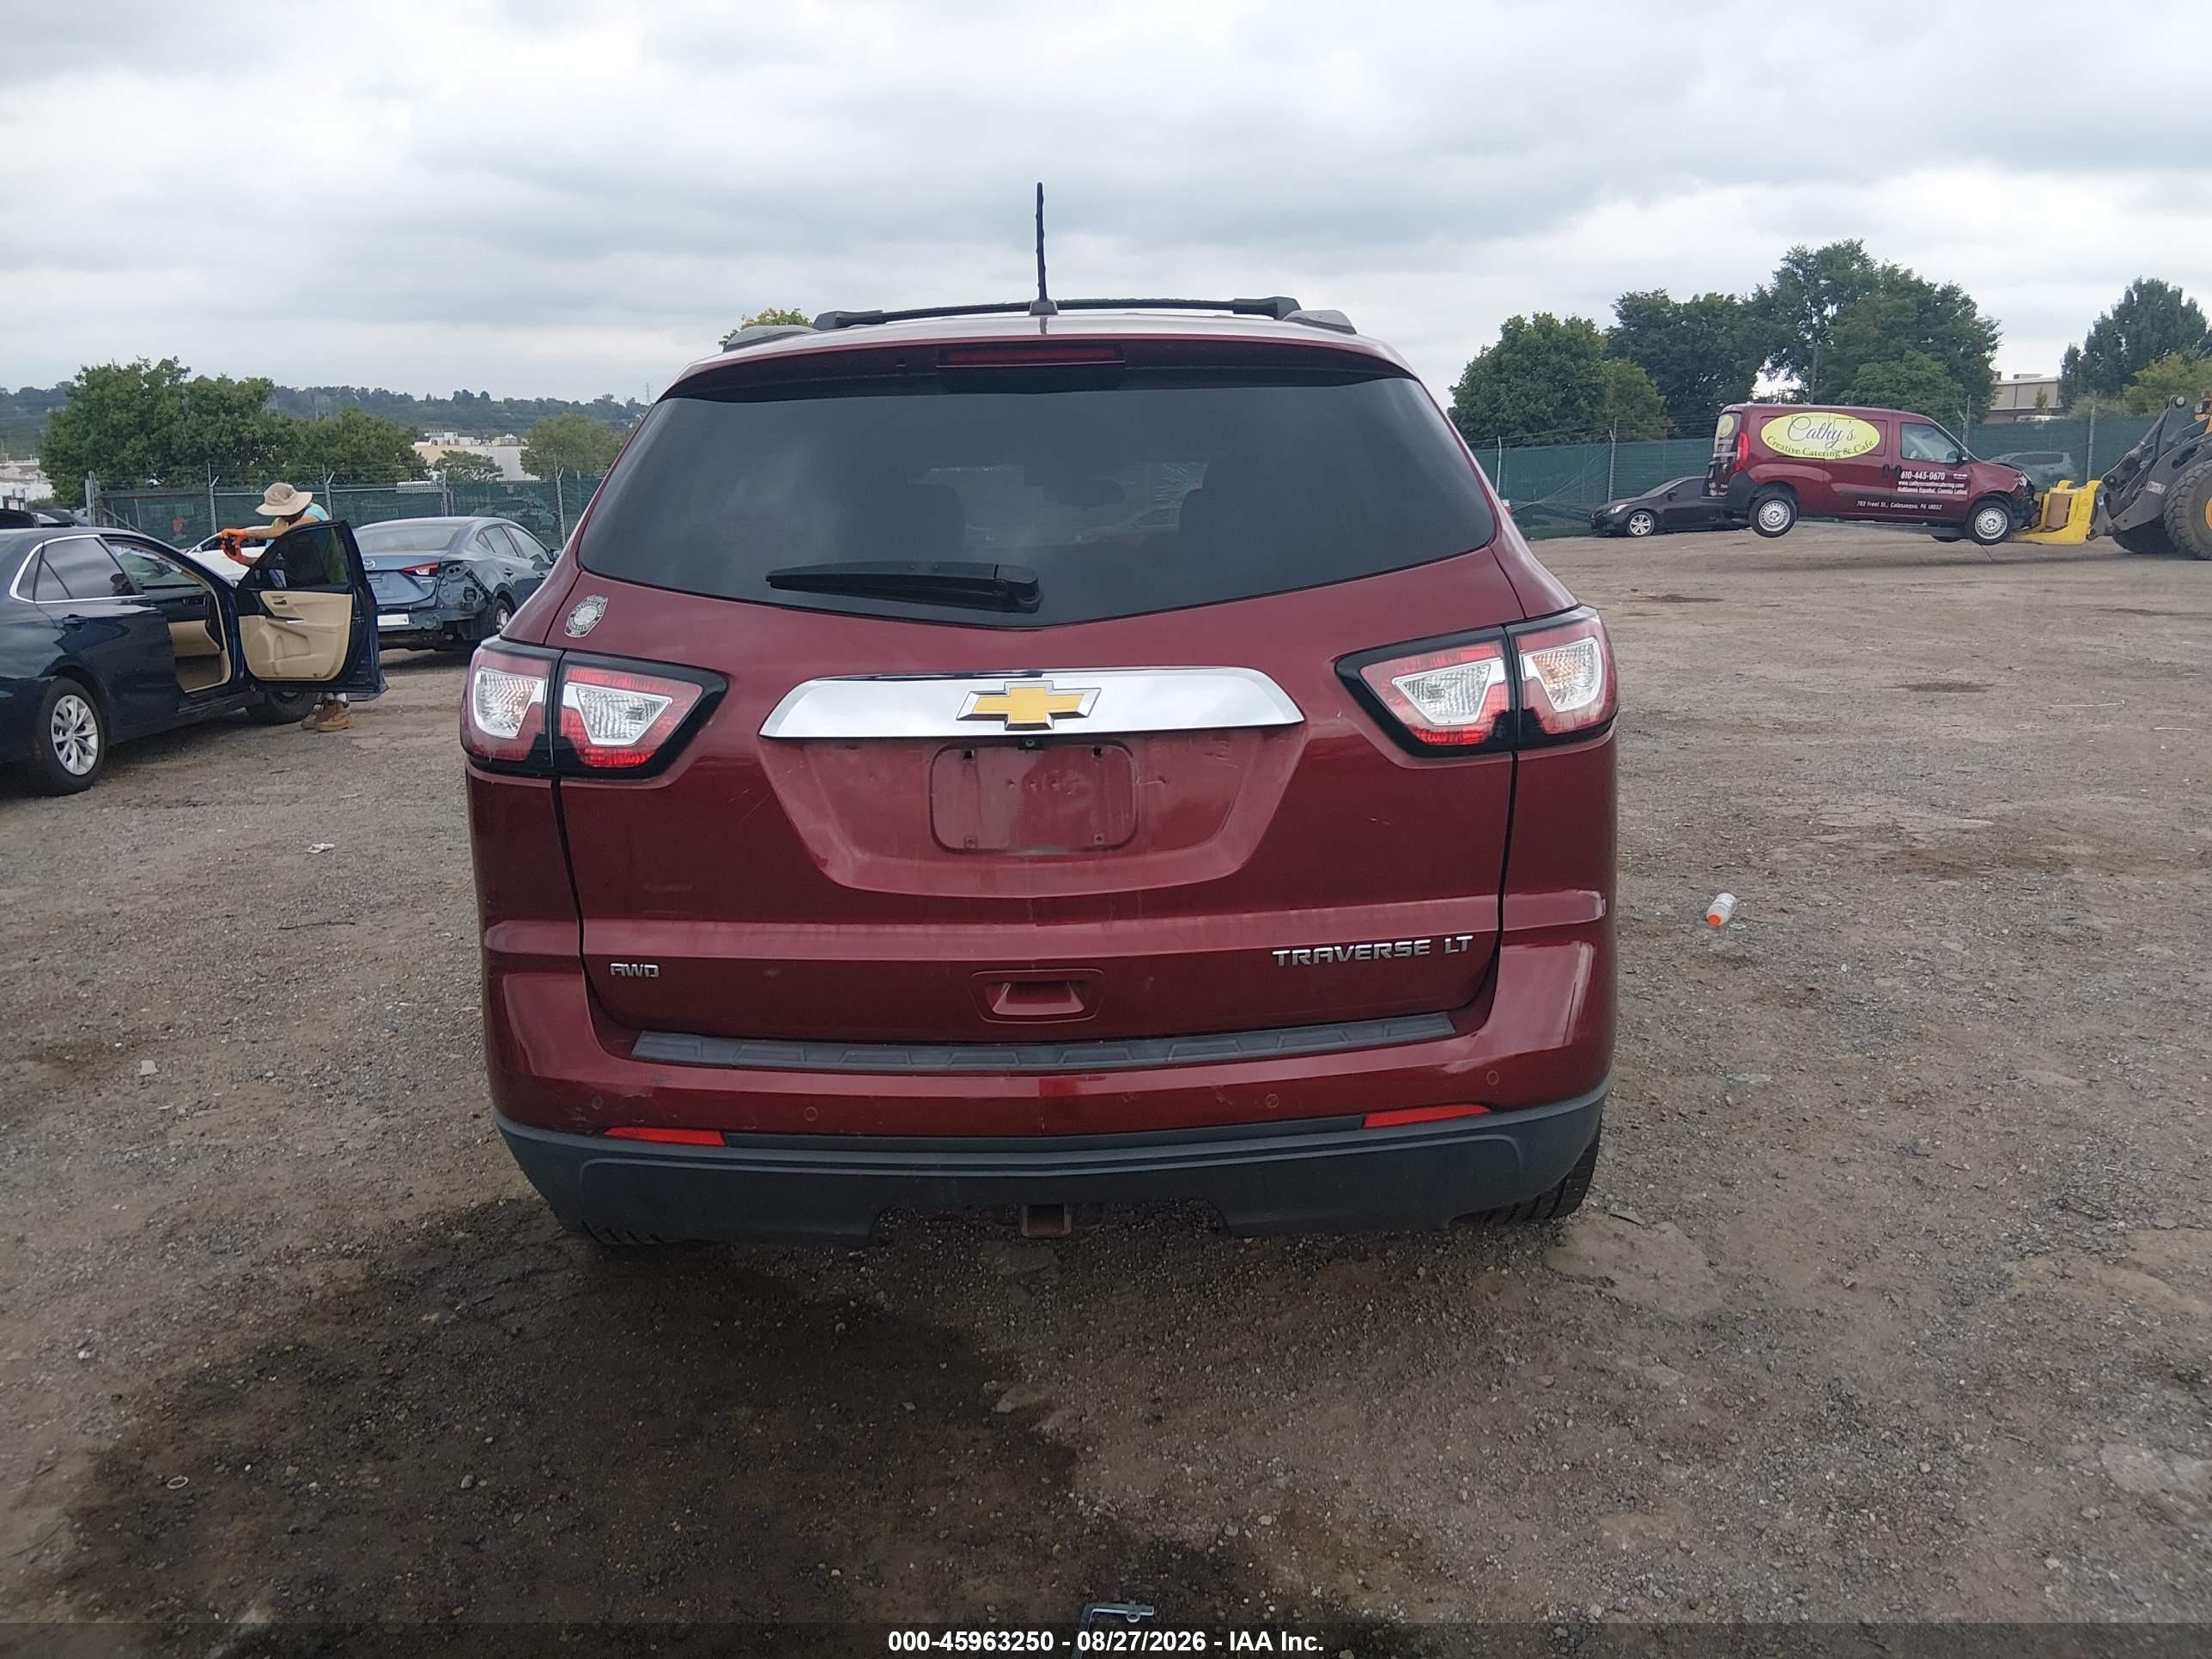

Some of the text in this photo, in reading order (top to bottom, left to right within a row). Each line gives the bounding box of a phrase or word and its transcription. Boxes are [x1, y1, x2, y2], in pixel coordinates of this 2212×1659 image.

[1788, 416, 1856, 449] Cathy's
[1766, 435, 1801, 455] Creative
[1802, 447, 1841, 458] Catering
[1843, 446, 1851, 455] &
[1272, 935, 1474, 967] TRAVERSE LT
[610, 963, 659, 977] AWD
